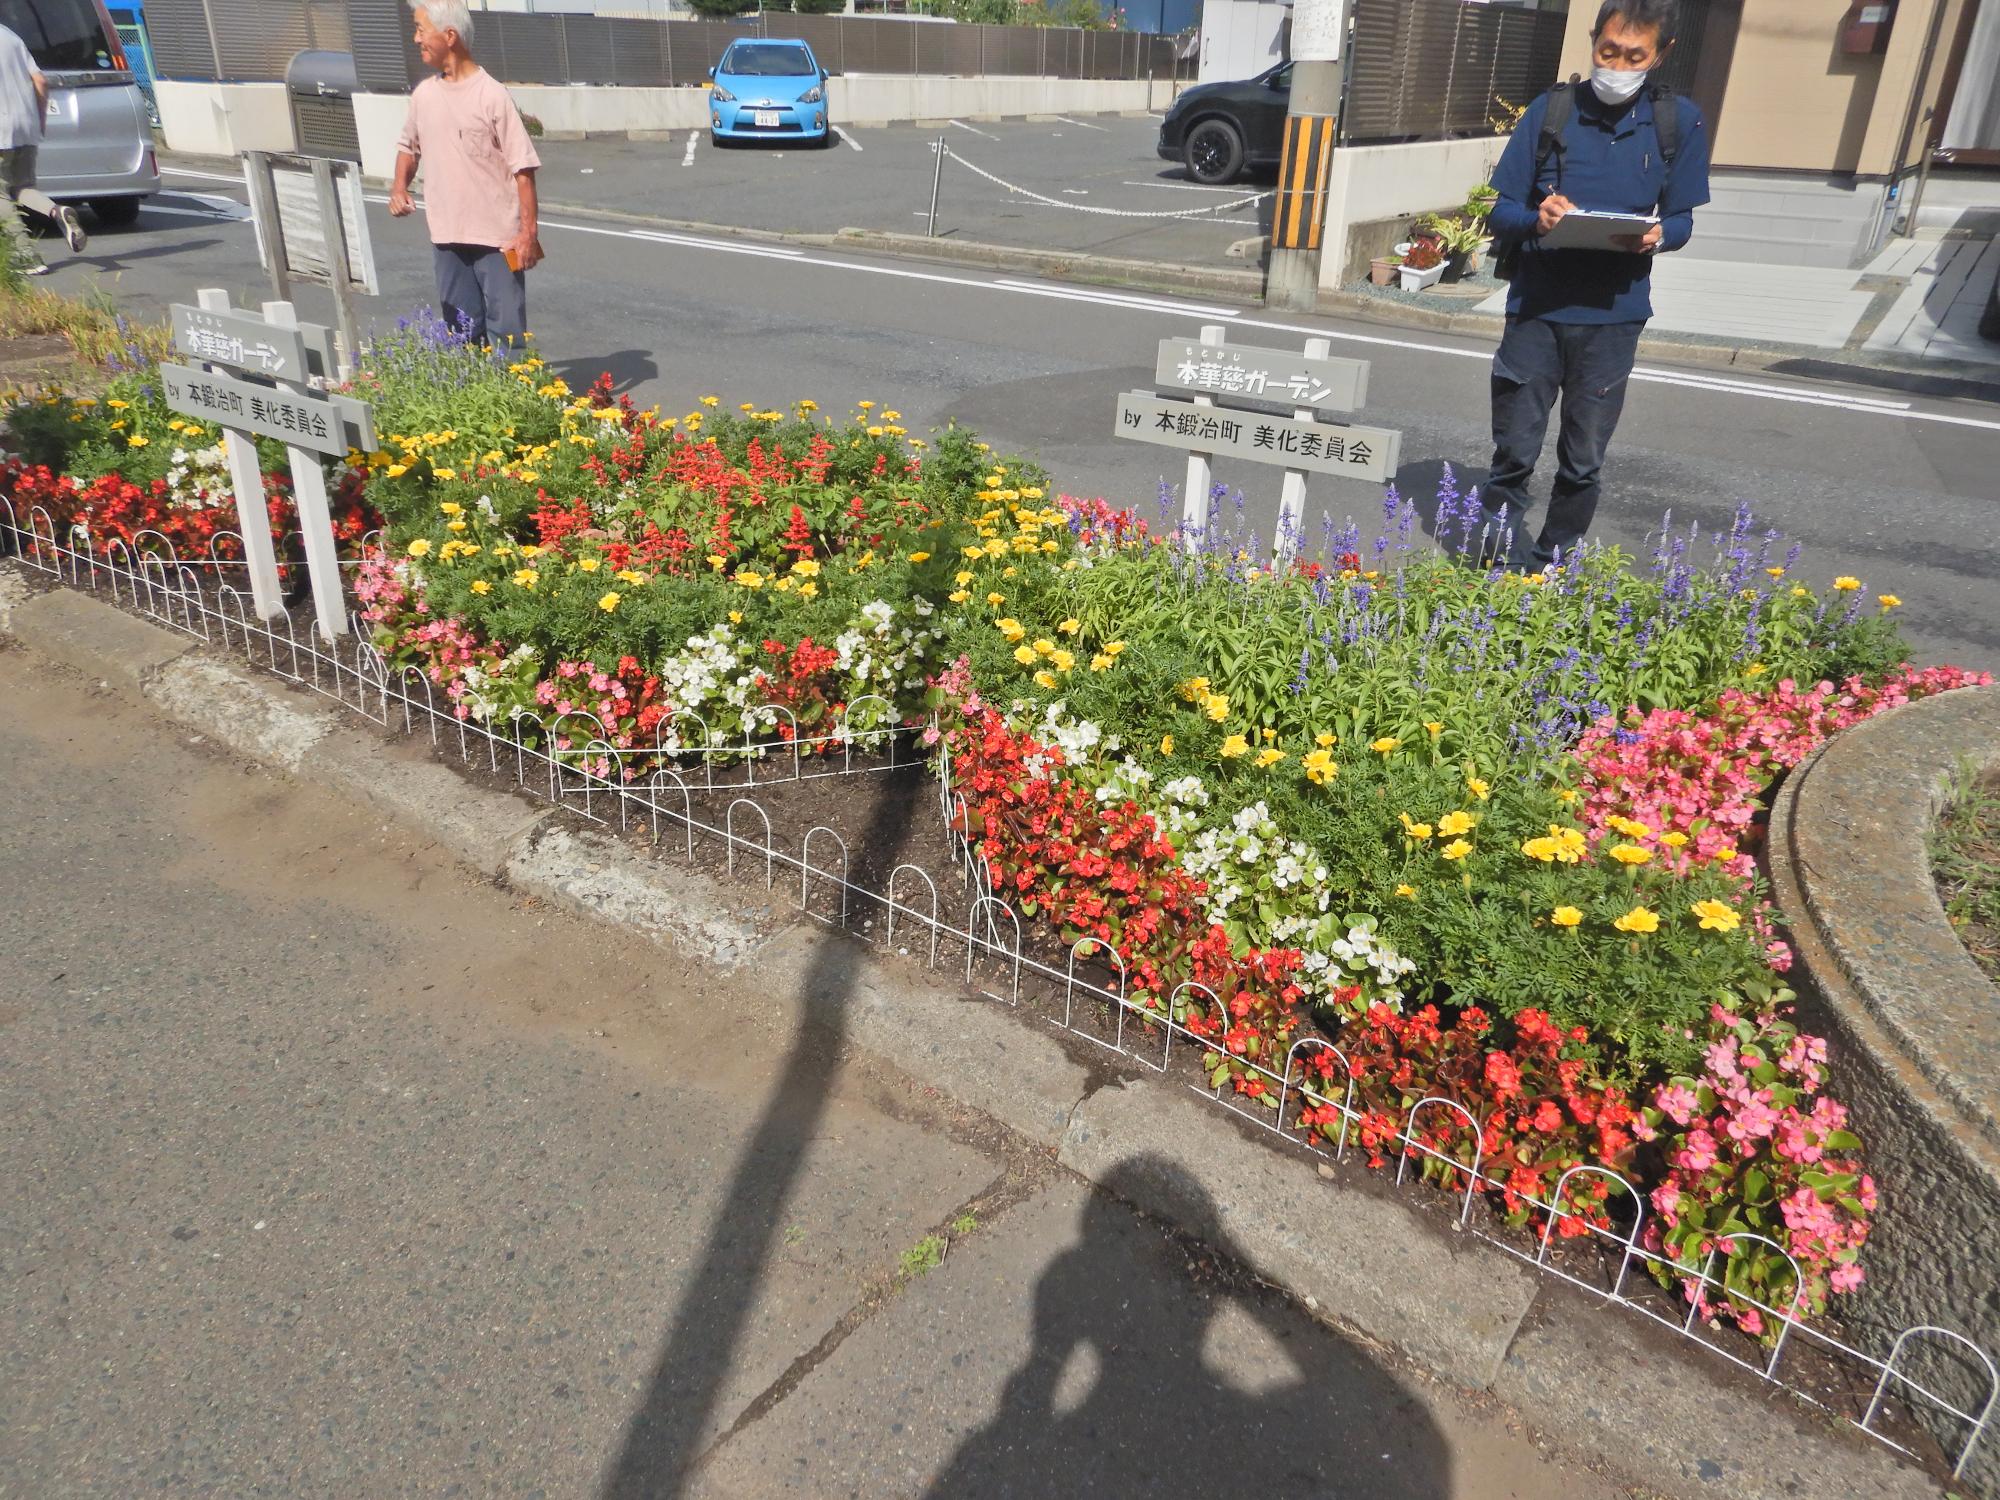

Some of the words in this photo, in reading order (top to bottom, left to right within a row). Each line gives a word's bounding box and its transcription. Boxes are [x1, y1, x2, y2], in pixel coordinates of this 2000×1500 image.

[167, 380, 180, 400] by
[249, 395, 328, 439] 美化委員会
[1177, 360, 1332, 403] 本華慈ガーデン
[1124, 408, 1142, 428] by
[1253, 424, 1372, 466] 美化委員会
